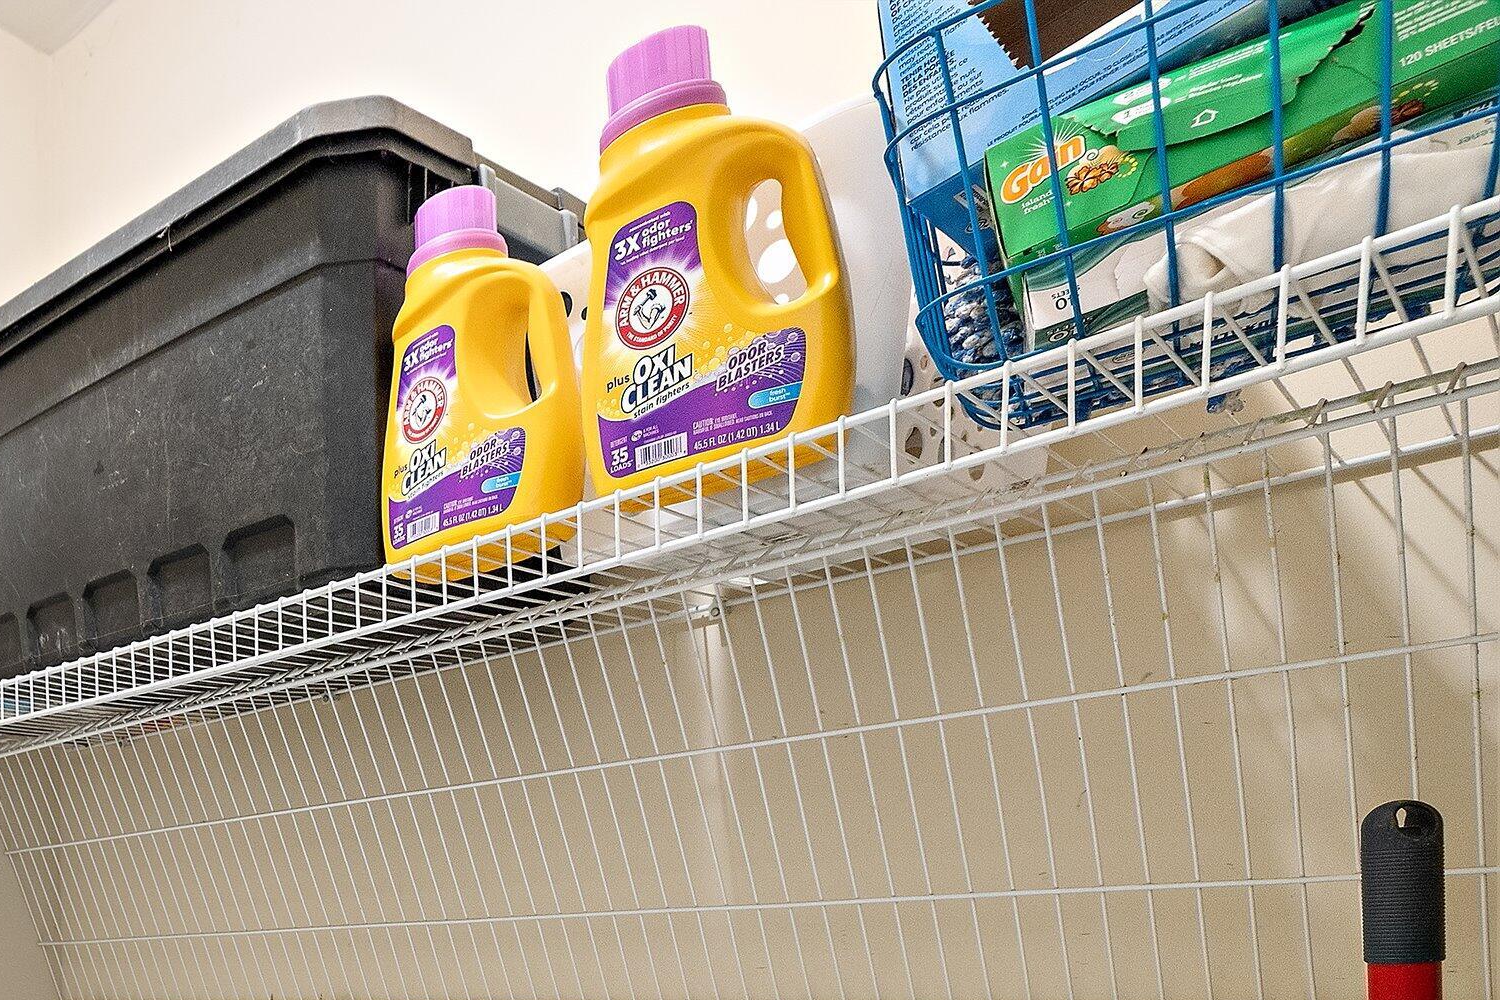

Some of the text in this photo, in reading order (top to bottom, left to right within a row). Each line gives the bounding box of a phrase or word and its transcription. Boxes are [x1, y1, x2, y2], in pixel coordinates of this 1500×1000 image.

[1400, 50, 1420, 67] 120
[1001, 134, 1086, 204] Gan
[613, 234, 640, 261] 3X
[642, 217, 671, 237] odor
[618, 271, 686, 327] ARM & HAMMER
[403, 348, 420, 373] 3X
[606, 344, 675, 394] plus OXI
[715, 346, 785, 392] BLASTERS
[728, 341, 768, 371] ODOR
[416, 380, 444, 408] HAMMER
[621, 354, 693, 413] CLEAN
[632, 381, 690, 419] stain fighters
[469, 438, 497, 460] ODOR
[610, 445, 629, 465] 35
[693, 439, 707, 450] 45.5
[708, 436, 715, 446] FL
[759, 422, 774, 434] 1.34
[393, 439, 437, 479] plus OXI
[401, 447, 447, 496] CLEAN
[461, 444, 510, 478] BLASTERS
